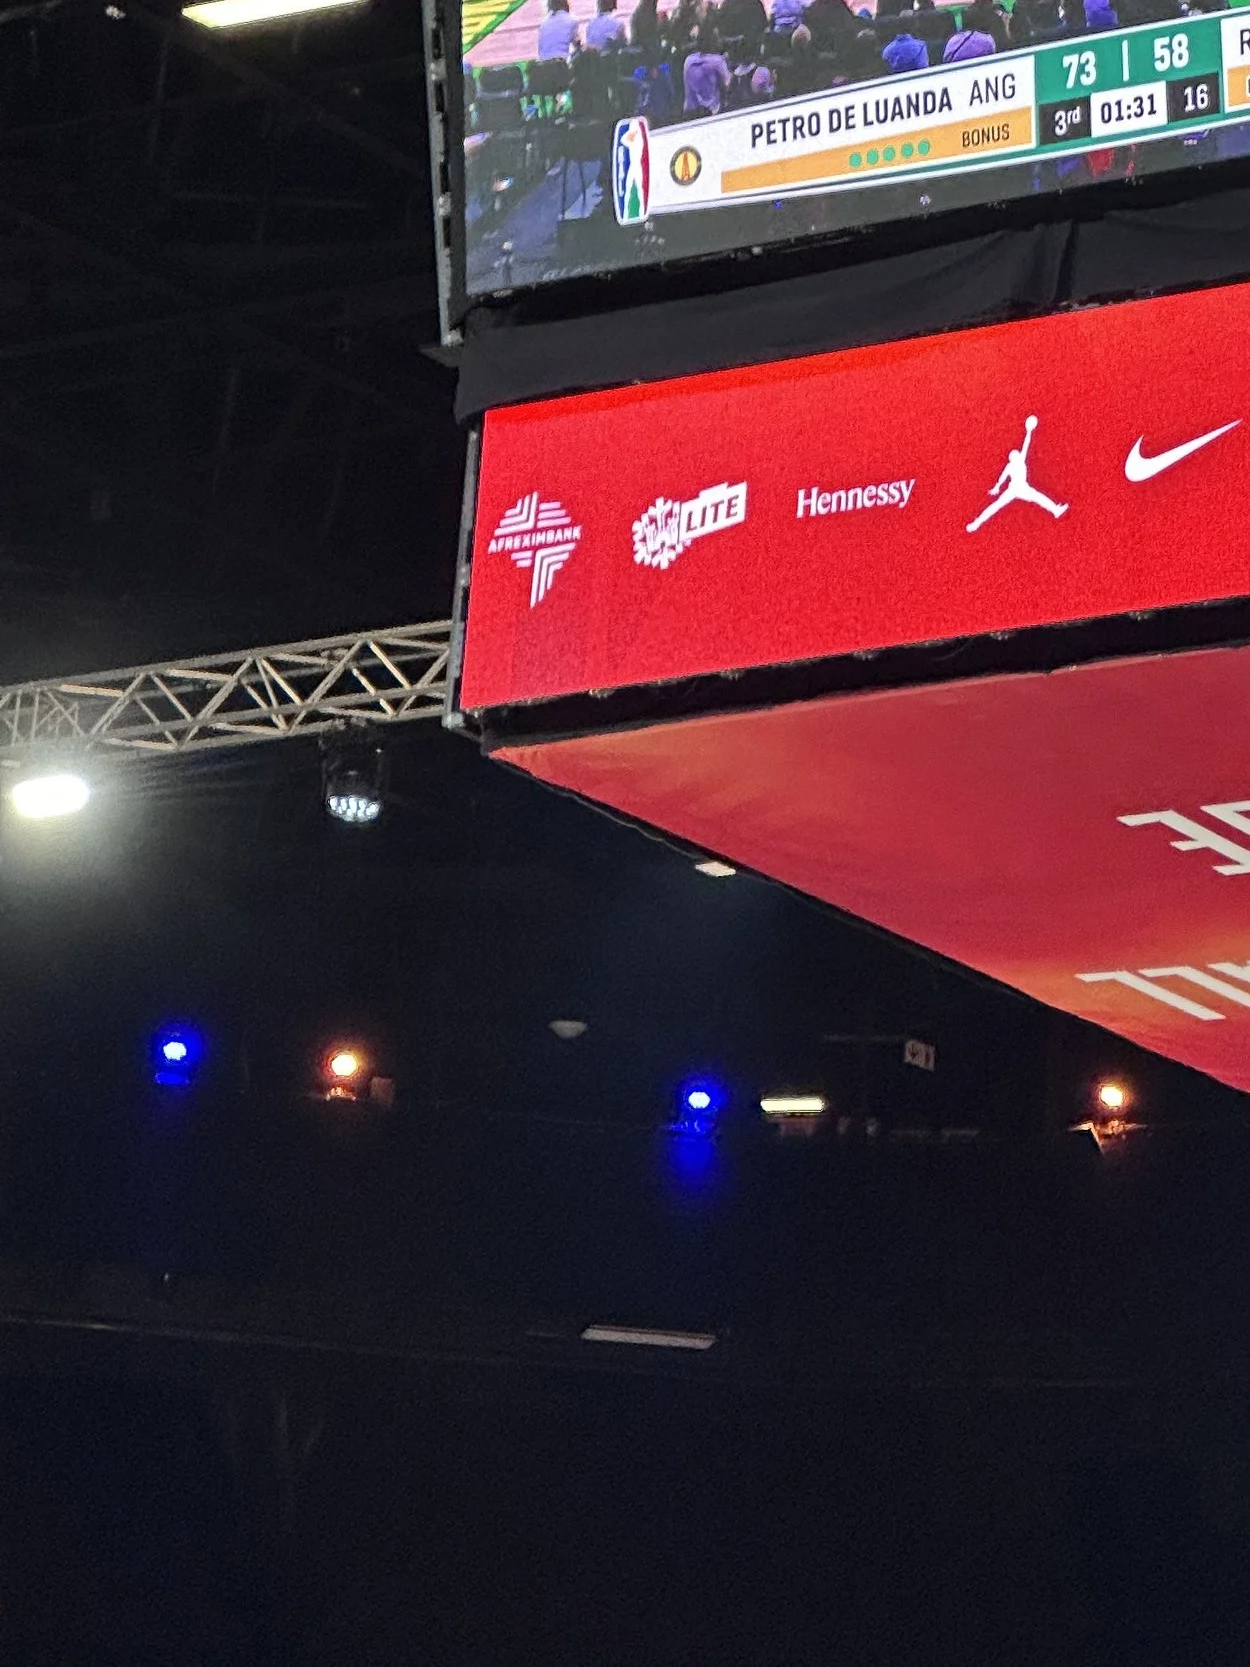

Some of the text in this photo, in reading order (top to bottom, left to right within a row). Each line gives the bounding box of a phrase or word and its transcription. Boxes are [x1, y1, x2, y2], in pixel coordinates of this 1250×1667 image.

[1062, 33, 1190, 89] 73 58
[751, 72, 1016, 148] PETRO DE LUANDA ANG
[1054, 83, 1209, 135] 3rd 01:31 16
[961, 123, 1011, 149] BONUS
[686, 494, 740, 533] LITE
[796, 478, 917, 520] Hennessy
